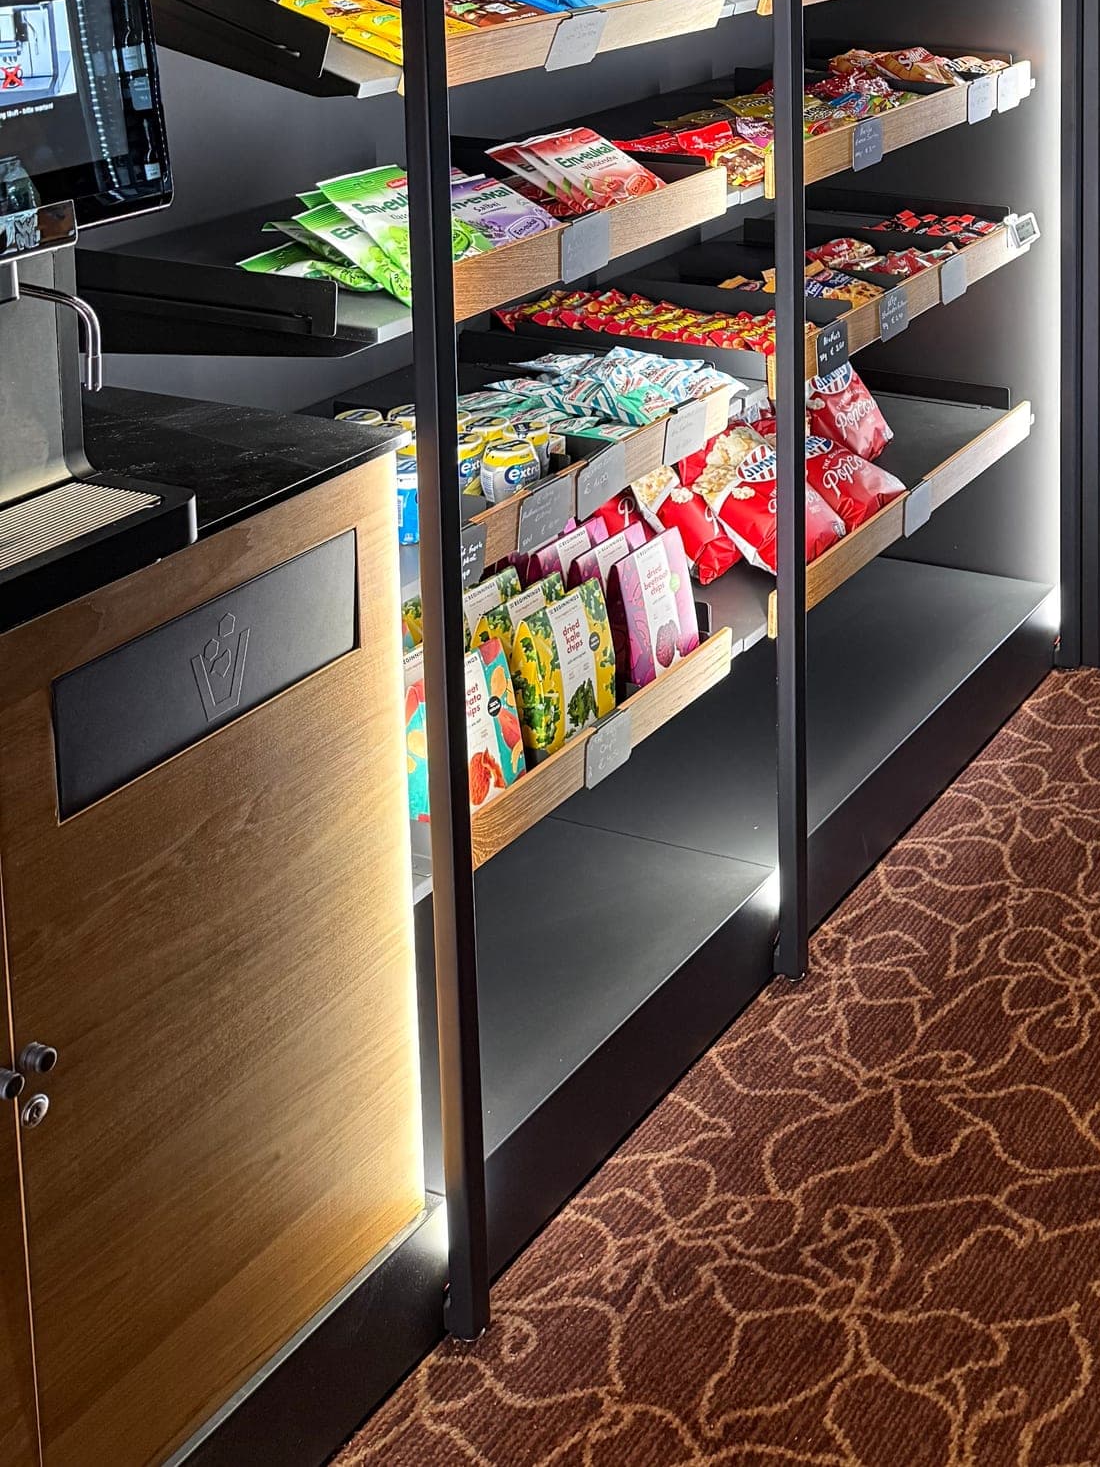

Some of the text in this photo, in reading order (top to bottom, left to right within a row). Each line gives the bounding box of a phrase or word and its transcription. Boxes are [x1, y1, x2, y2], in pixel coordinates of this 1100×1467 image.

[646, 565, 663, 579] dried
[514, 587, 541, 605] BEGINNINGS
[650, 581, 666, 596] chips
[553, 595, 580, 612] BEGINNINGS
[562, 619, 580, 636] dried
[565, 630, 581, 645] kale
[566, 639, 584, 655] chips
